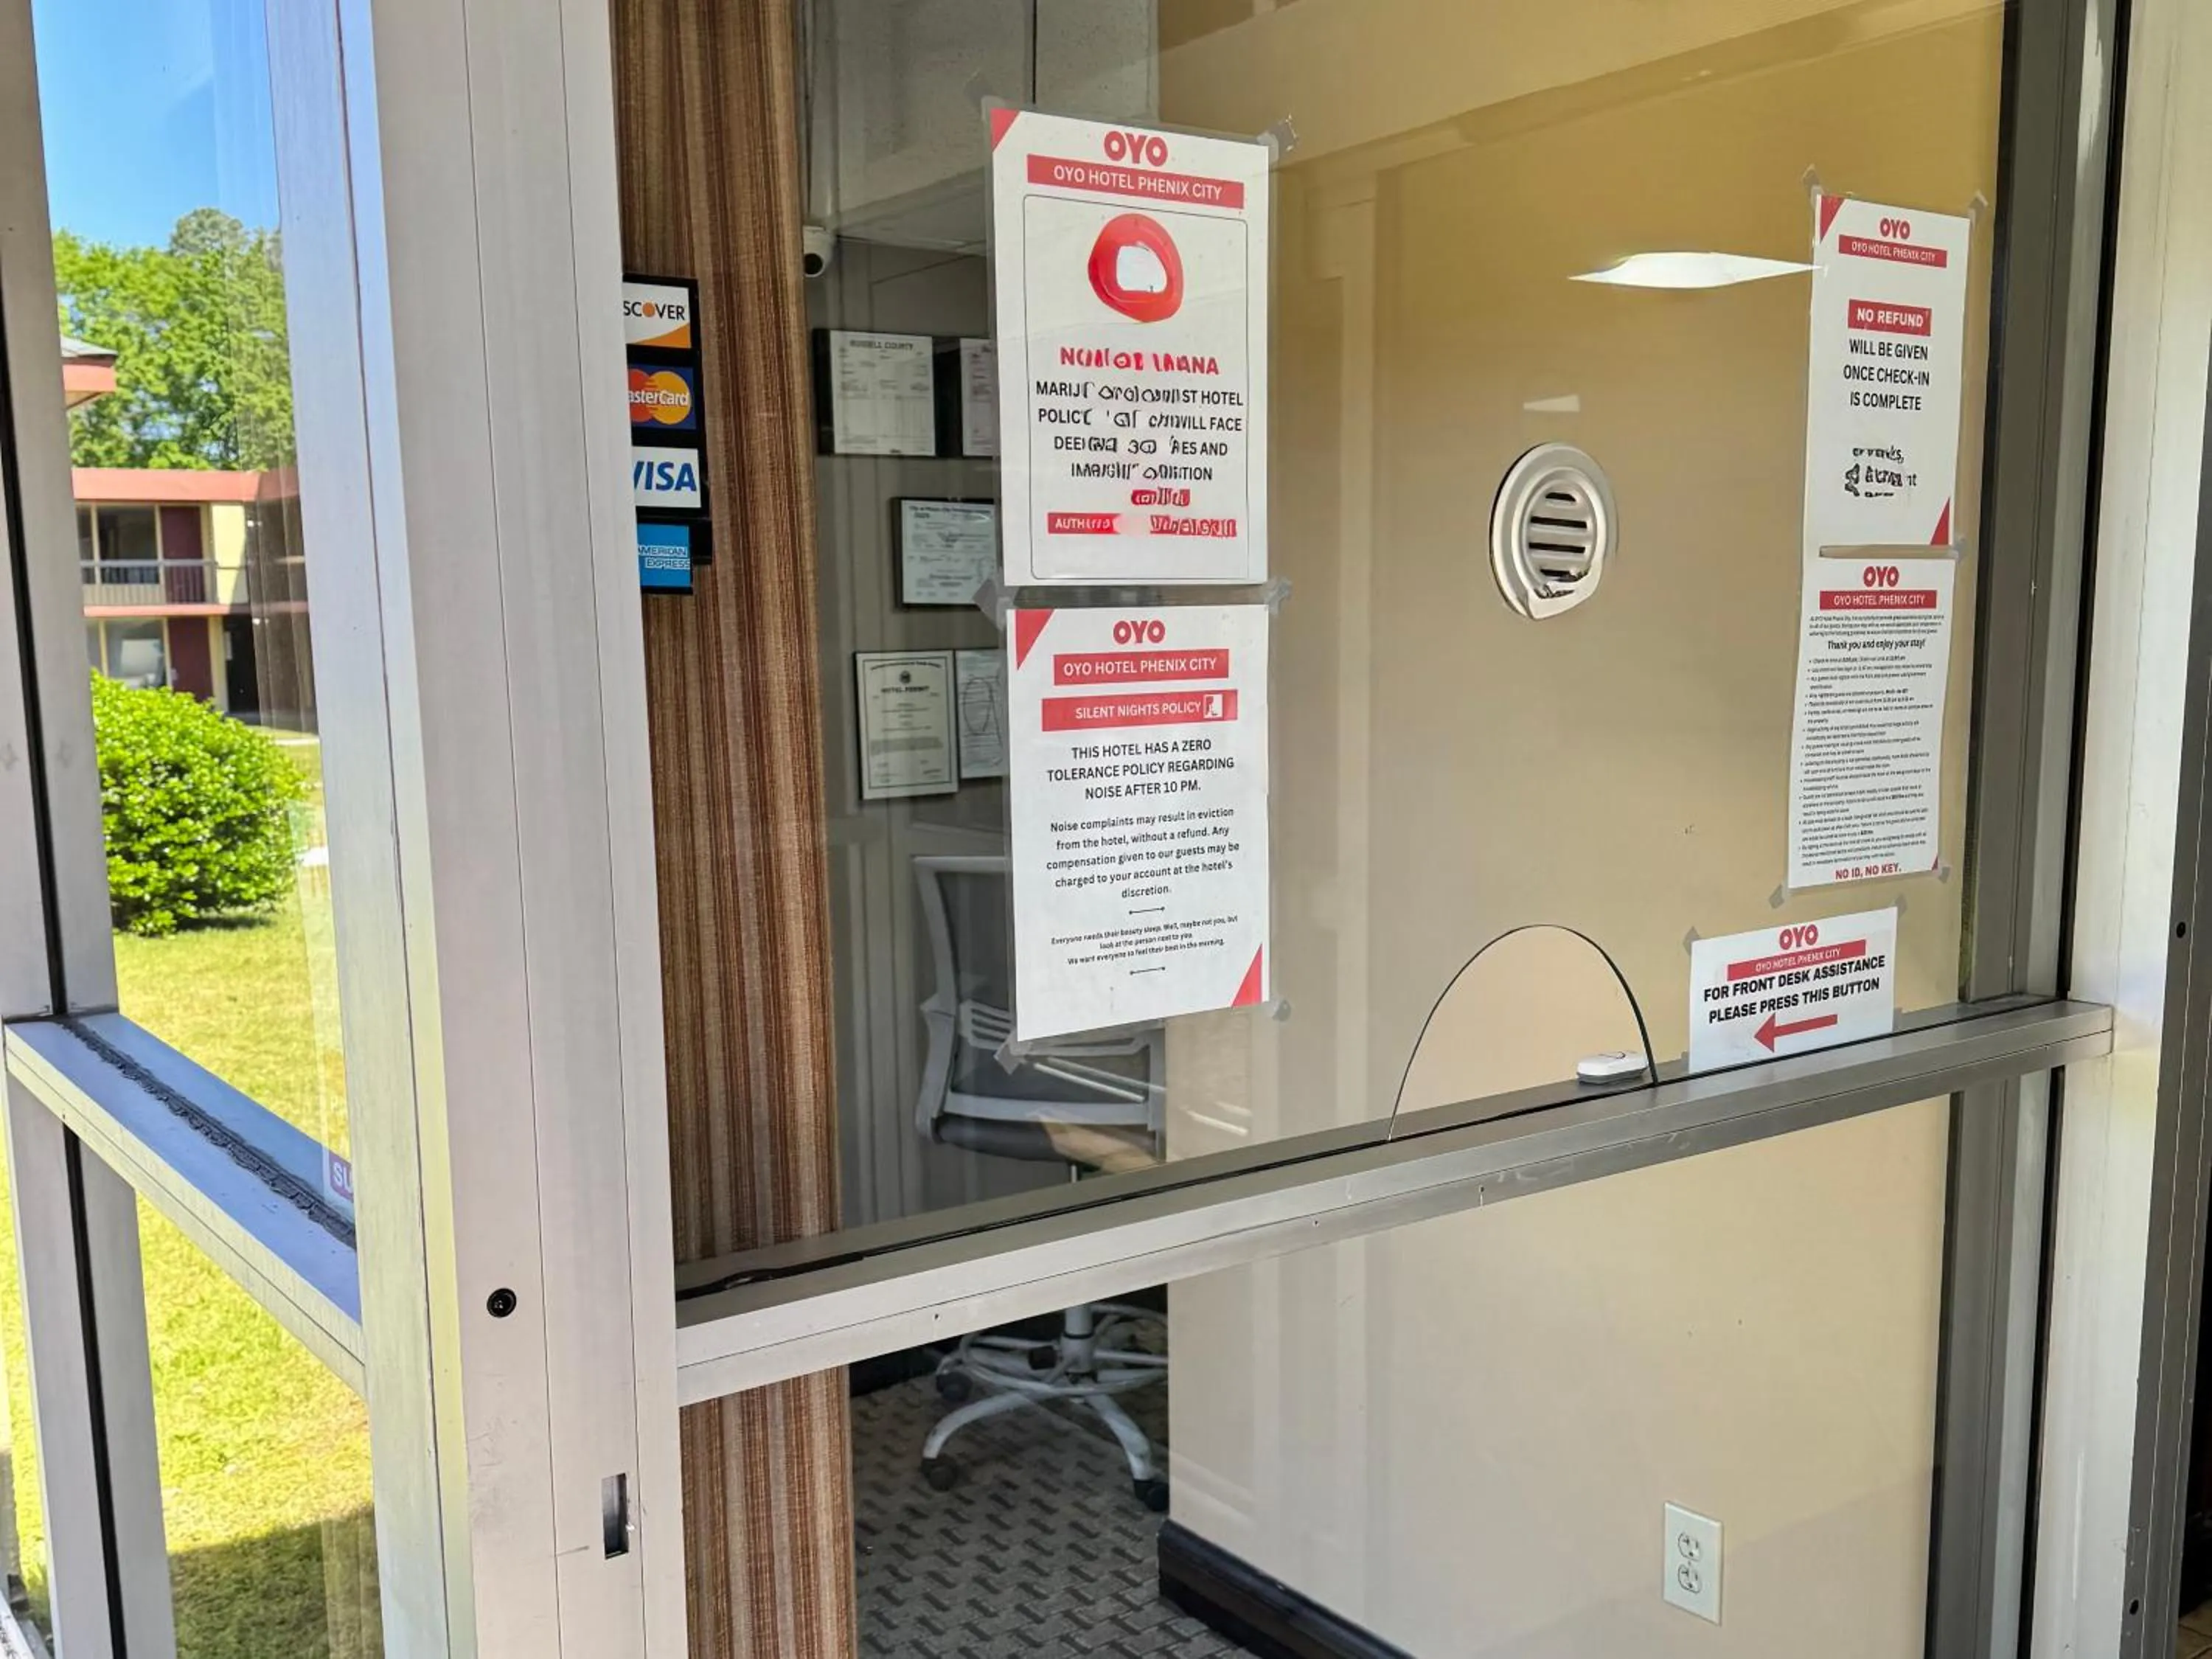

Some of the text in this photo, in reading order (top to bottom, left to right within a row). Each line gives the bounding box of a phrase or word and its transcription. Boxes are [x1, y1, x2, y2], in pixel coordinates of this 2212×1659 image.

[1104, 131, 1168, 167] OYO
[1054, 165, 1222, 200] OYO HOTEL PHENIX CITY
[1879, 218, 1910, 240] OYO
[1851, 241, 1935, 262] OYO HOTEL PHENIX CITY
[1857, 307, 1924, 327] NO REFUND
[1849, 339, 1928, 361] WILL BE GIVEN
[1843, 365, 1930, 386] ONCE CHECK-IN
[1201, 390, 1243, 406] HOTEL
[1850, 392, 1922, 411] IS COMPLETE
[1210, 417, 1242, 431] FACE
[1200, 442, 1228, 456] AND
[1863, 566, 1899, 588] OYO
[1834, 595, 1926, 606] OYO HOTEL PHENIX CITY
[1113, 620, 1166, 644] OYO
[1064, 658, 1216, 676] OYO HOTEL PHENIX CITY
[1076, 702, 1201, 720] SILENT NIGHTS POLICY
[1072, 740, 1211, 759] THIS HOTEL HAS A ZERO
[1047, 758, 1235, 782] TOLERANCE POLICY REGARDING
[1085, 780, 1201, 799] NOISE AFTER 10 PM.
[1051, 807, 1234, 832] Noise complaints may result in eviction
[1056, 840, 1080, 850] from
[1082, 838, 1099, 847] the
[1101, 835, 1129, 846] hotel,
[1130, 832, 1167, 844] without
[1177, 827, 1210, 839] refund.
[1211, 827, 1229, 837] Any
[1046, 841, 1239, 871] compensation given to our guests may be
[1055, 859, 1233, 888] charged to your account at the hotel's
[1835, 869, 1849, 880] NO
[1865, 866, 1879, 876] NO
[1881, 863, 1902, 874] KEY.
[1121, 885, 1172, 898] discretion.
[1779, 924, 1819, 950] OYO
[1773, 958, 1795, 971] HOTEL
[1825, 947, 1841, 959] CITY
[1704, 955, 1885, 1002] FOR FRONT DESK ASSISTANCE
[1708, 977, 1880, 1024] PLEASE PRESS THIS BUTTON
